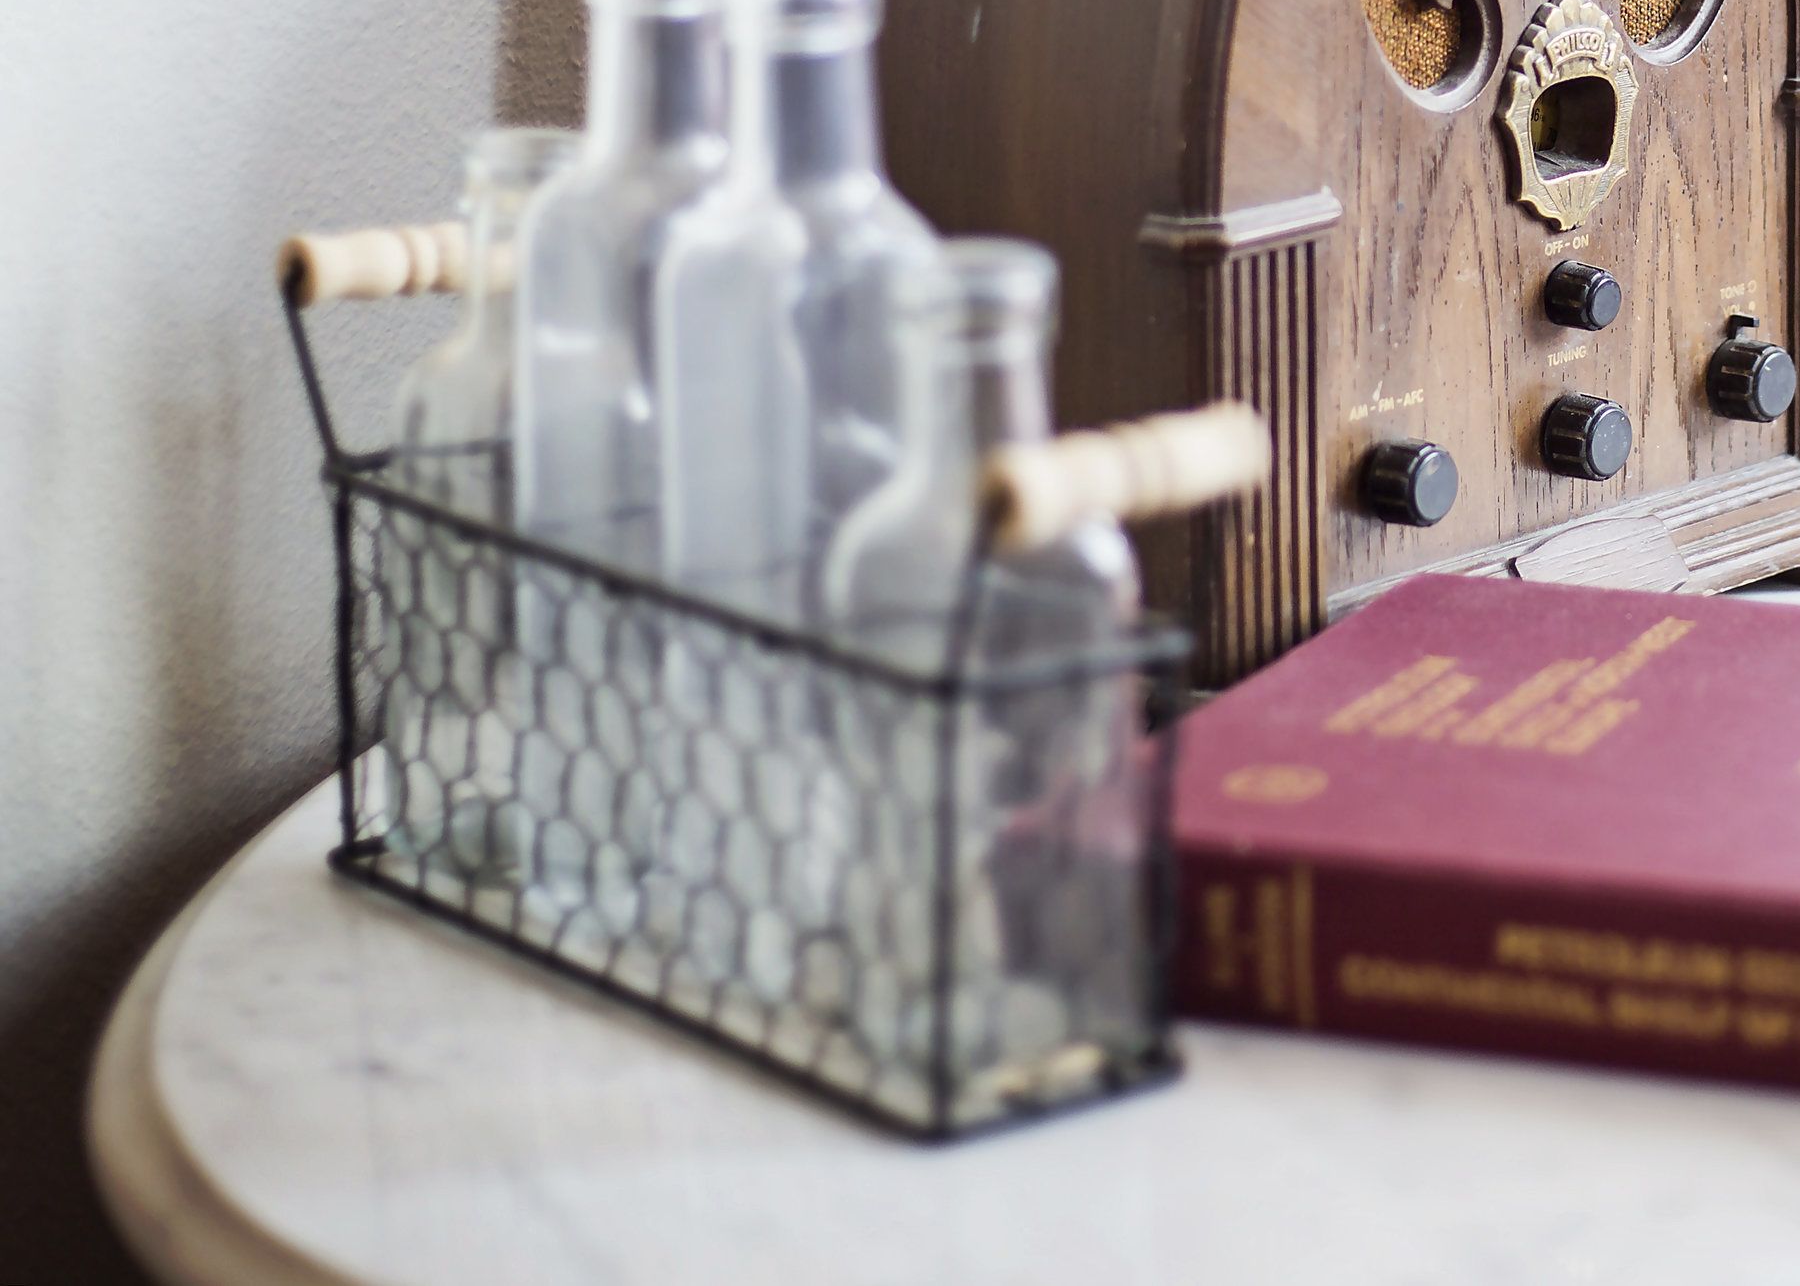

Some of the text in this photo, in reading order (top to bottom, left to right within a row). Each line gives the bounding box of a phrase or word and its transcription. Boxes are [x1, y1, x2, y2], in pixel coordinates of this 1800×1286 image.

[1551, 32, 1601, 58] PHILCO
[1720, 283, 1745, 300] TONE
[1547, 345, 1587, 366] TUNING
